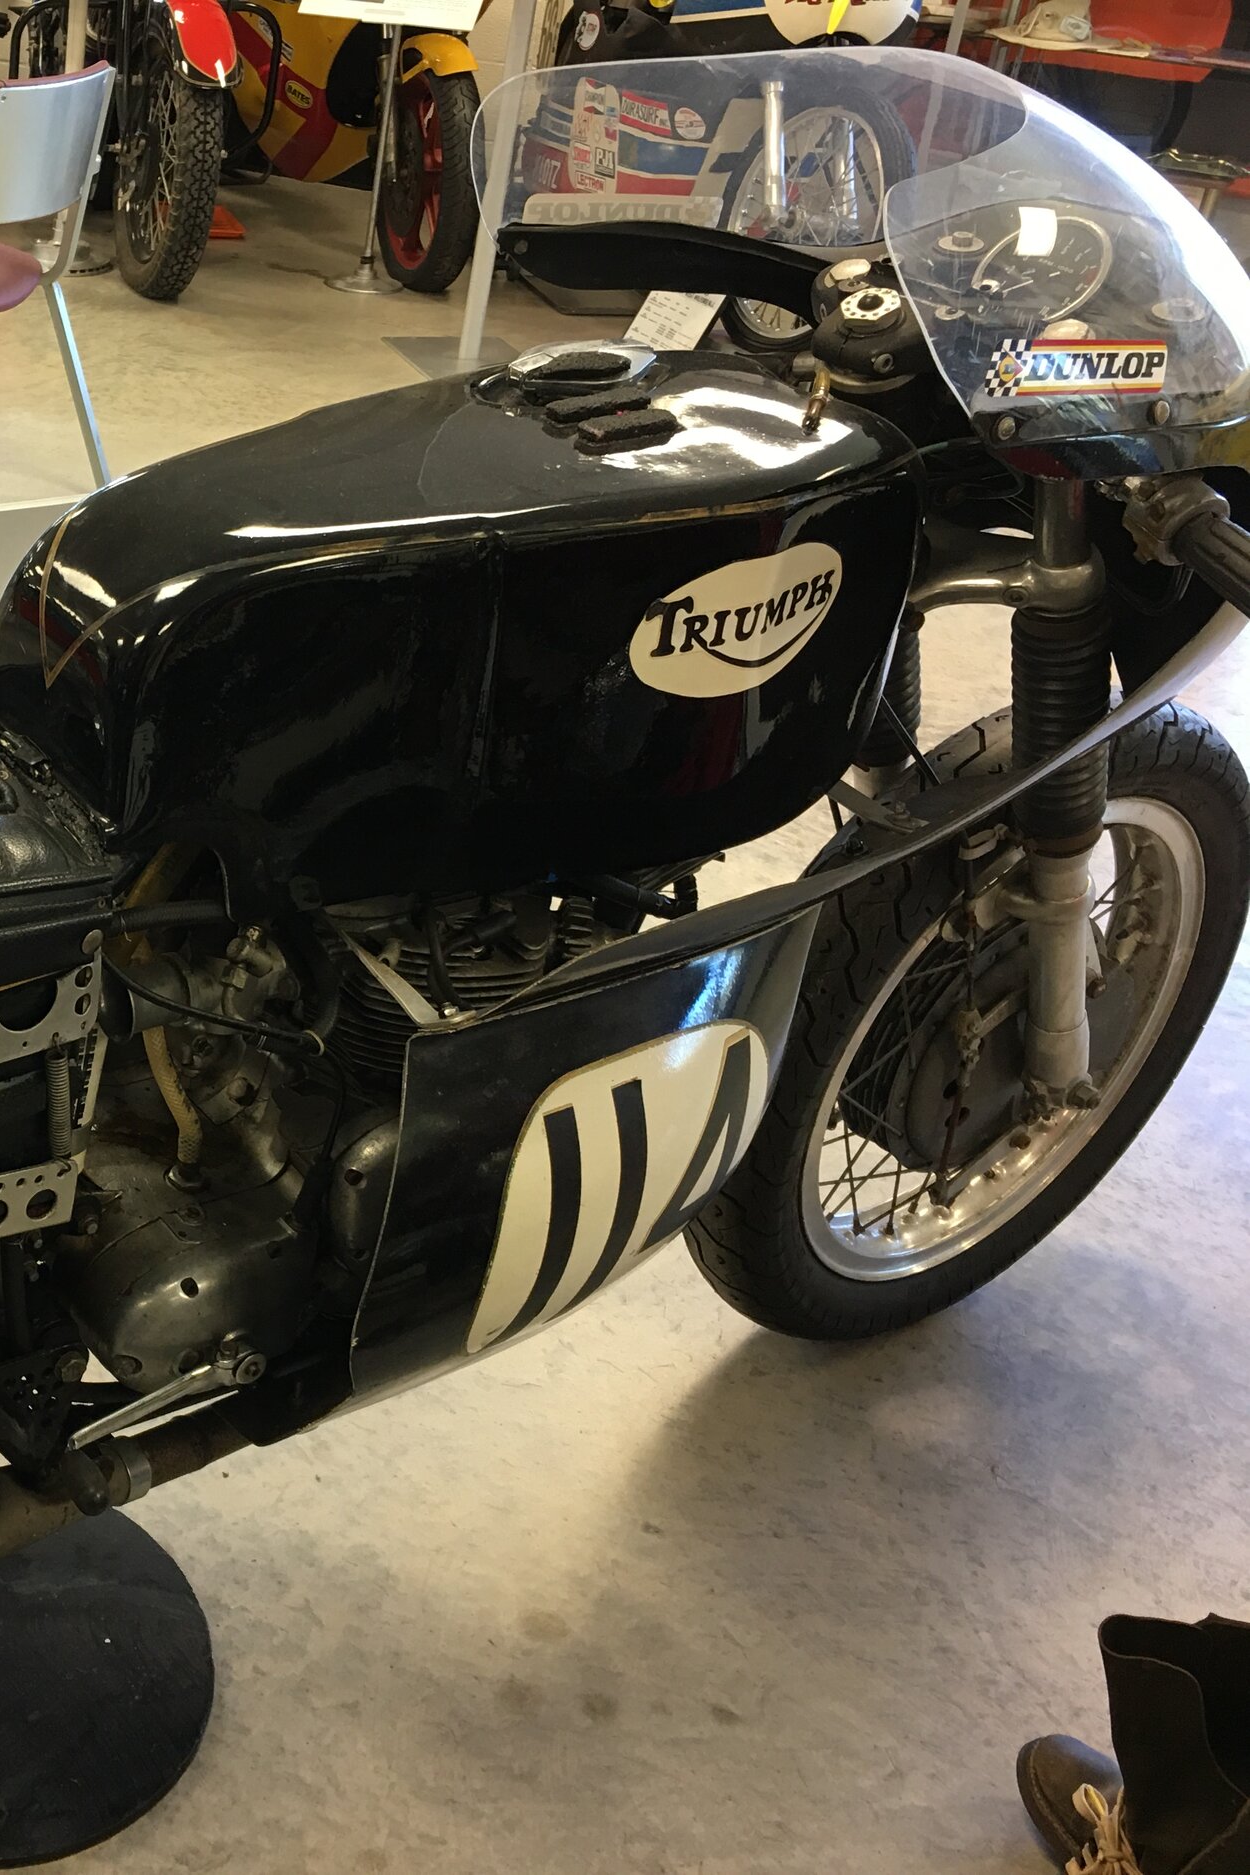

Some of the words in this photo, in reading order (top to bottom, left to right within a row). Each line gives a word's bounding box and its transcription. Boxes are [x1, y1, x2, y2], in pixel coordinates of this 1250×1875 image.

[621, 99, 659, 125] DURASURF
[595, 148, 615, 169] PJ1
[1022, 352, 1165, 382] DUNLOP
[645, 569, 835, 668] TRIUMPH
